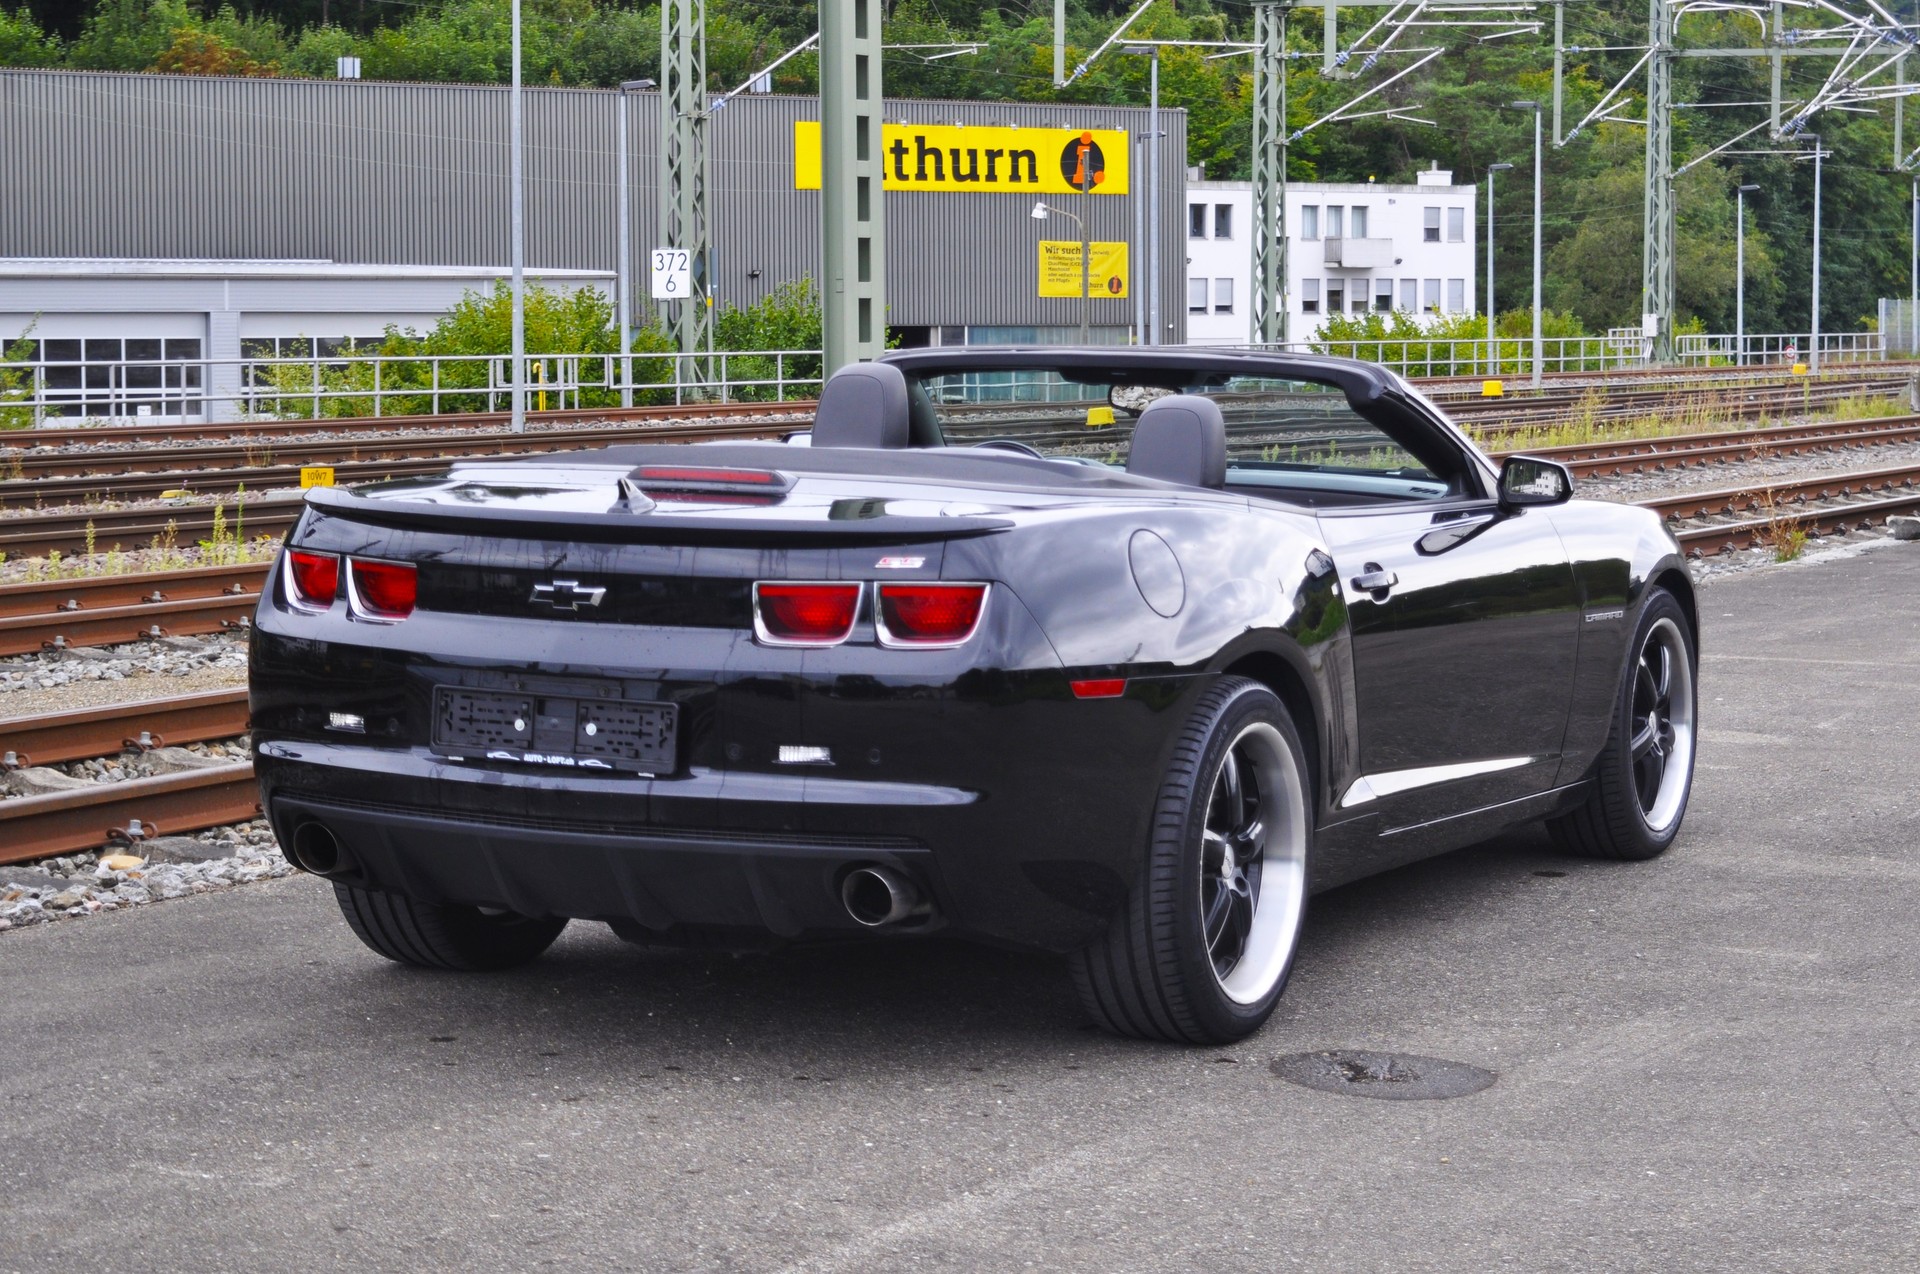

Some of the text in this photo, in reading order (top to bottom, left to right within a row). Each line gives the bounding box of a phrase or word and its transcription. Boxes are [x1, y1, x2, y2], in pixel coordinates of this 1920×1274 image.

[882, 135, 1039, 184] thurn
[1045, 246, 1059, 254] Wir
[1061, 246, 1091, 255] suchn
[655, 252, 687, 271] 372
[666, 274, 676, 292] 6
